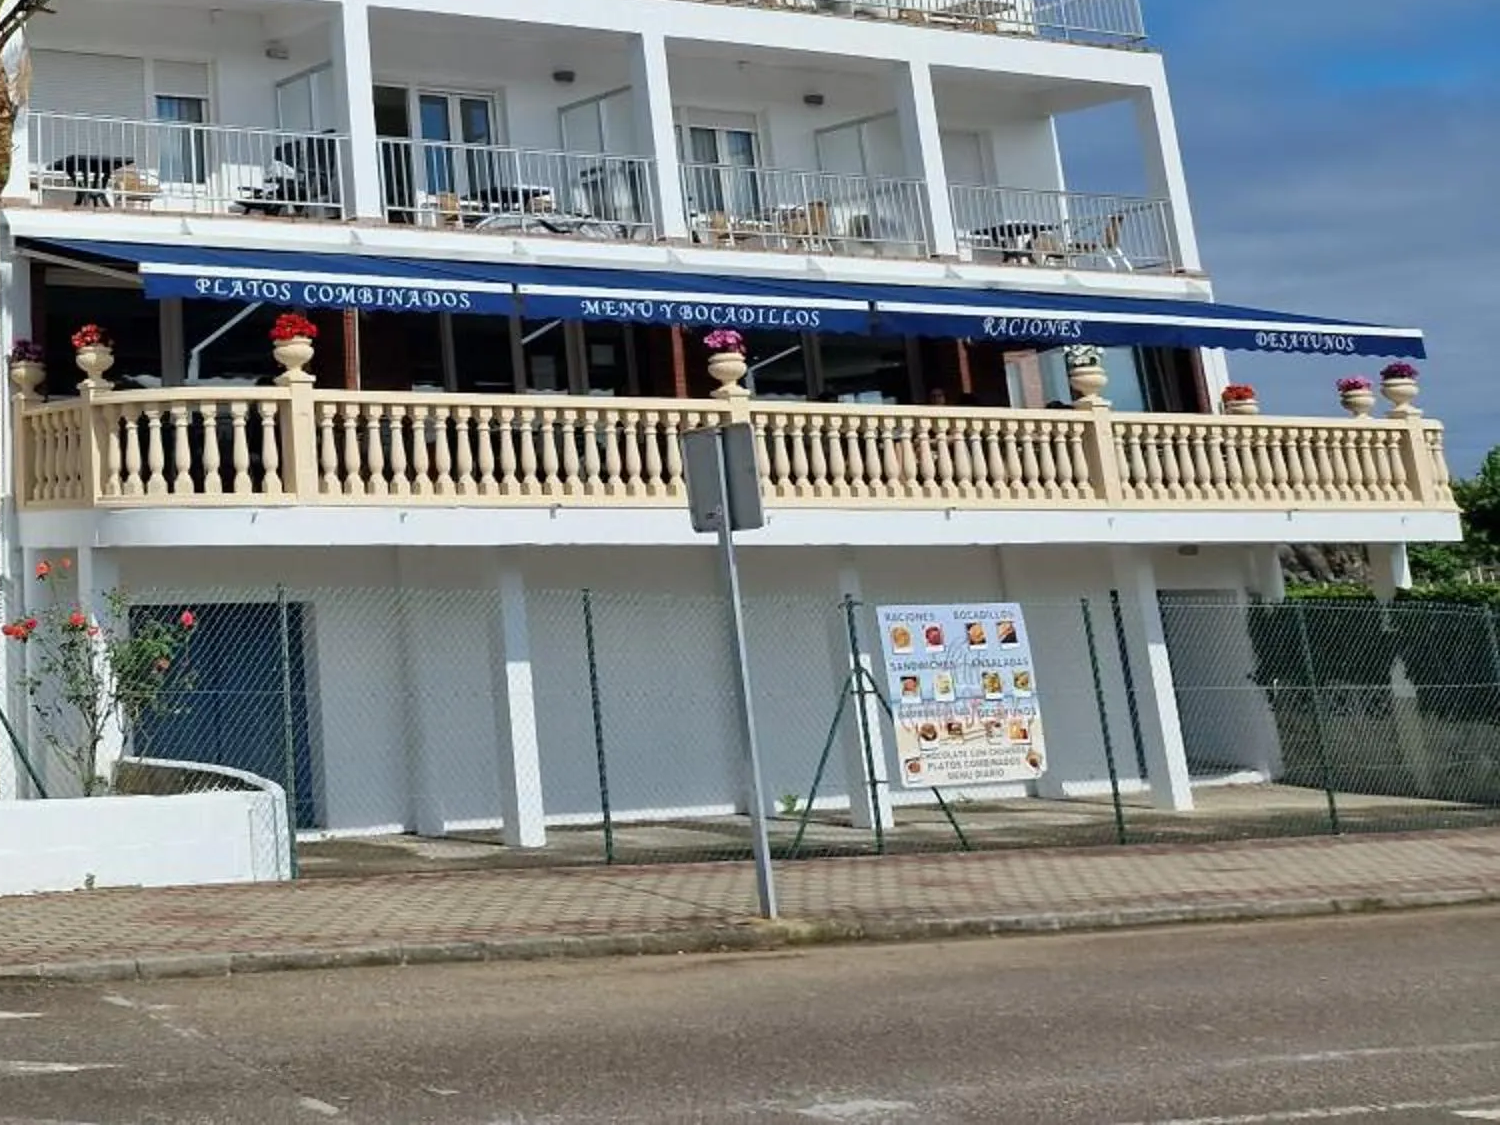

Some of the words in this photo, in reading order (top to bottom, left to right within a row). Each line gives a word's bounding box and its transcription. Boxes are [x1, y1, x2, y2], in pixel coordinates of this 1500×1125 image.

[195, 277, 292, 302] PLATOS
[303, 284, 472, 309] COMBINADOS
[659, 302, 676, 319] Y
[678, 304, 821, 328] BOCADILLOS
[982, 316, 1083, 338] RACIONES
